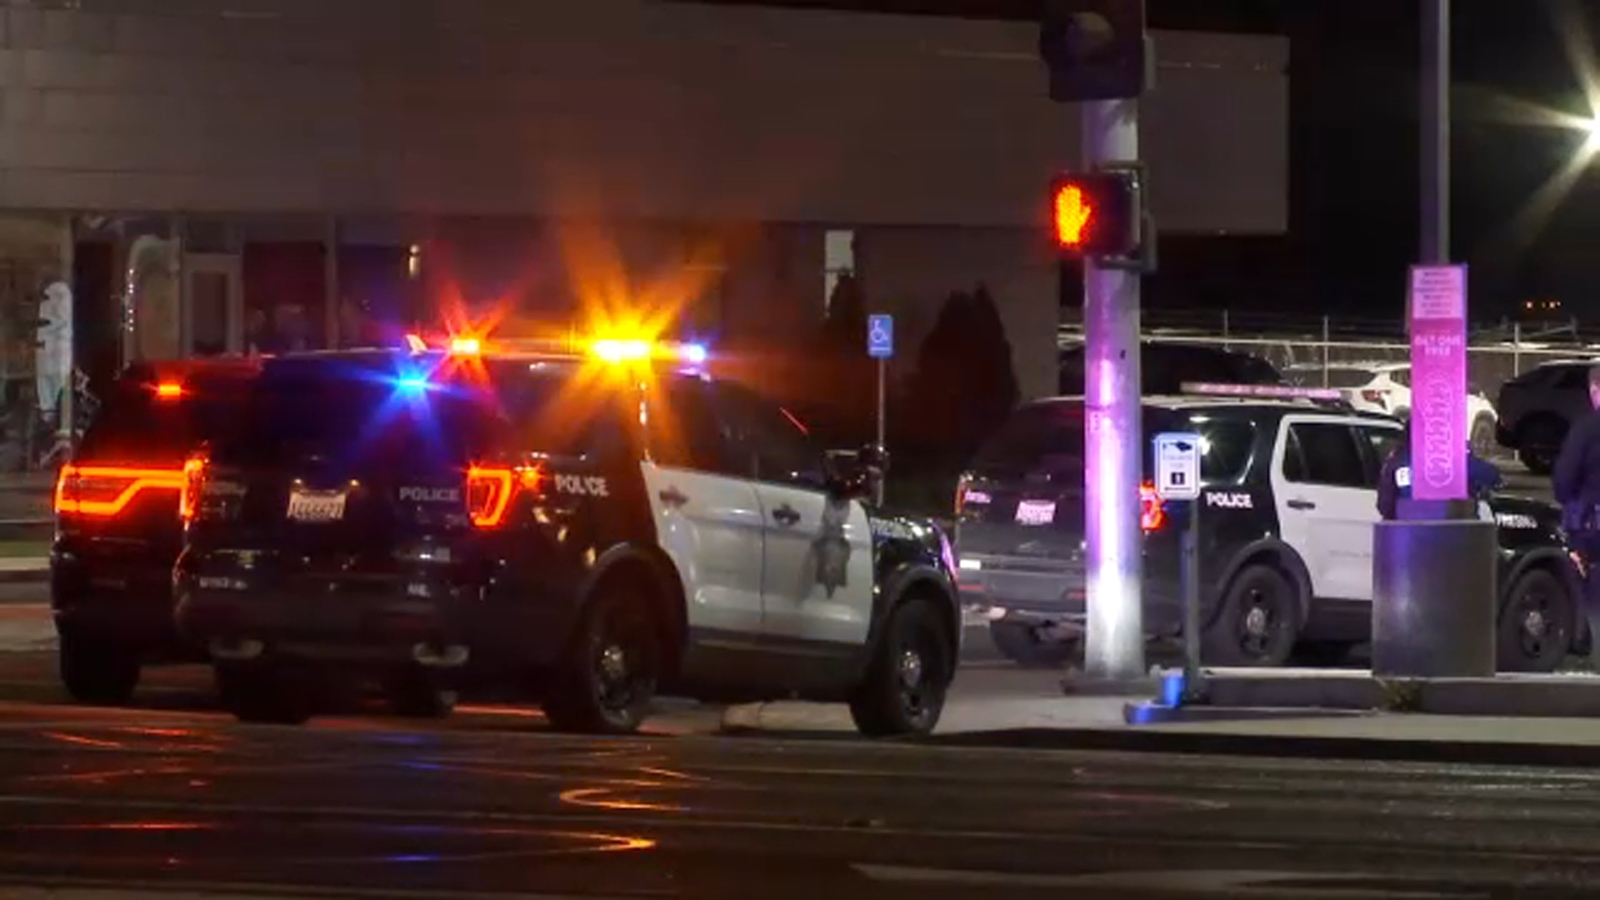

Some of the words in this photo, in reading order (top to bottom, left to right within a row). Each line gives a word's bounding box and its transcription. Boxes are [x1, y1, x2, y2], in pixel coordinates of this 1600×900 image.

[554, 474, 609, 497] POLICE
[400, 487, 460, 501] POLICE
[1206, 492, 1253, 508] POLICE
